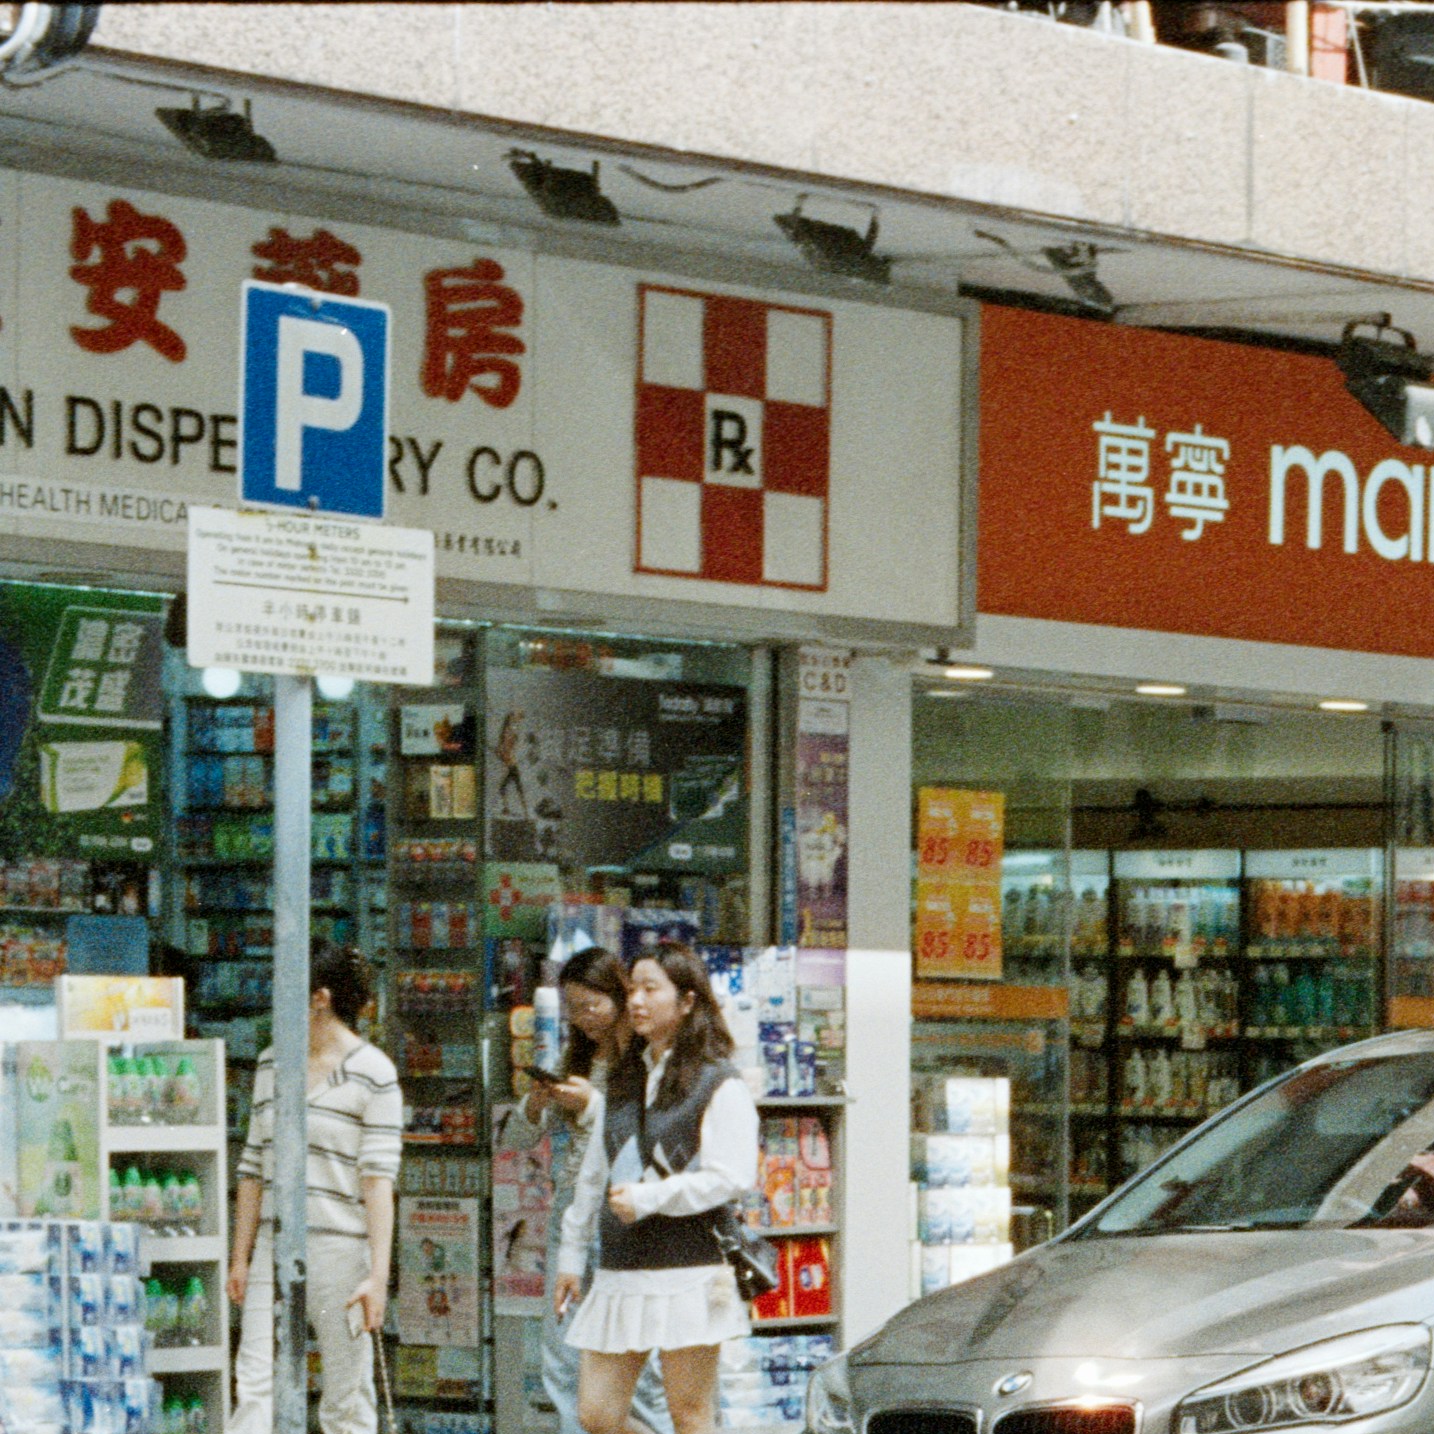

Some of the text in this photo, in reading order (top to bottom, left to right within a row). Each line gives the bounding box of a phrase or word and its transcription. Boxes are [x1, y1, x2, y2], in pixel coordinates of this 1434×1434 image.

[65, 394, 443, 495] DISPERY
[466, 446, 558, 510] CO.
[275, 315, 364, 490] P
[0, 483, 189, 523] HEALTH MEDICA
[1092, 411, 1230, 541] 萬寧
